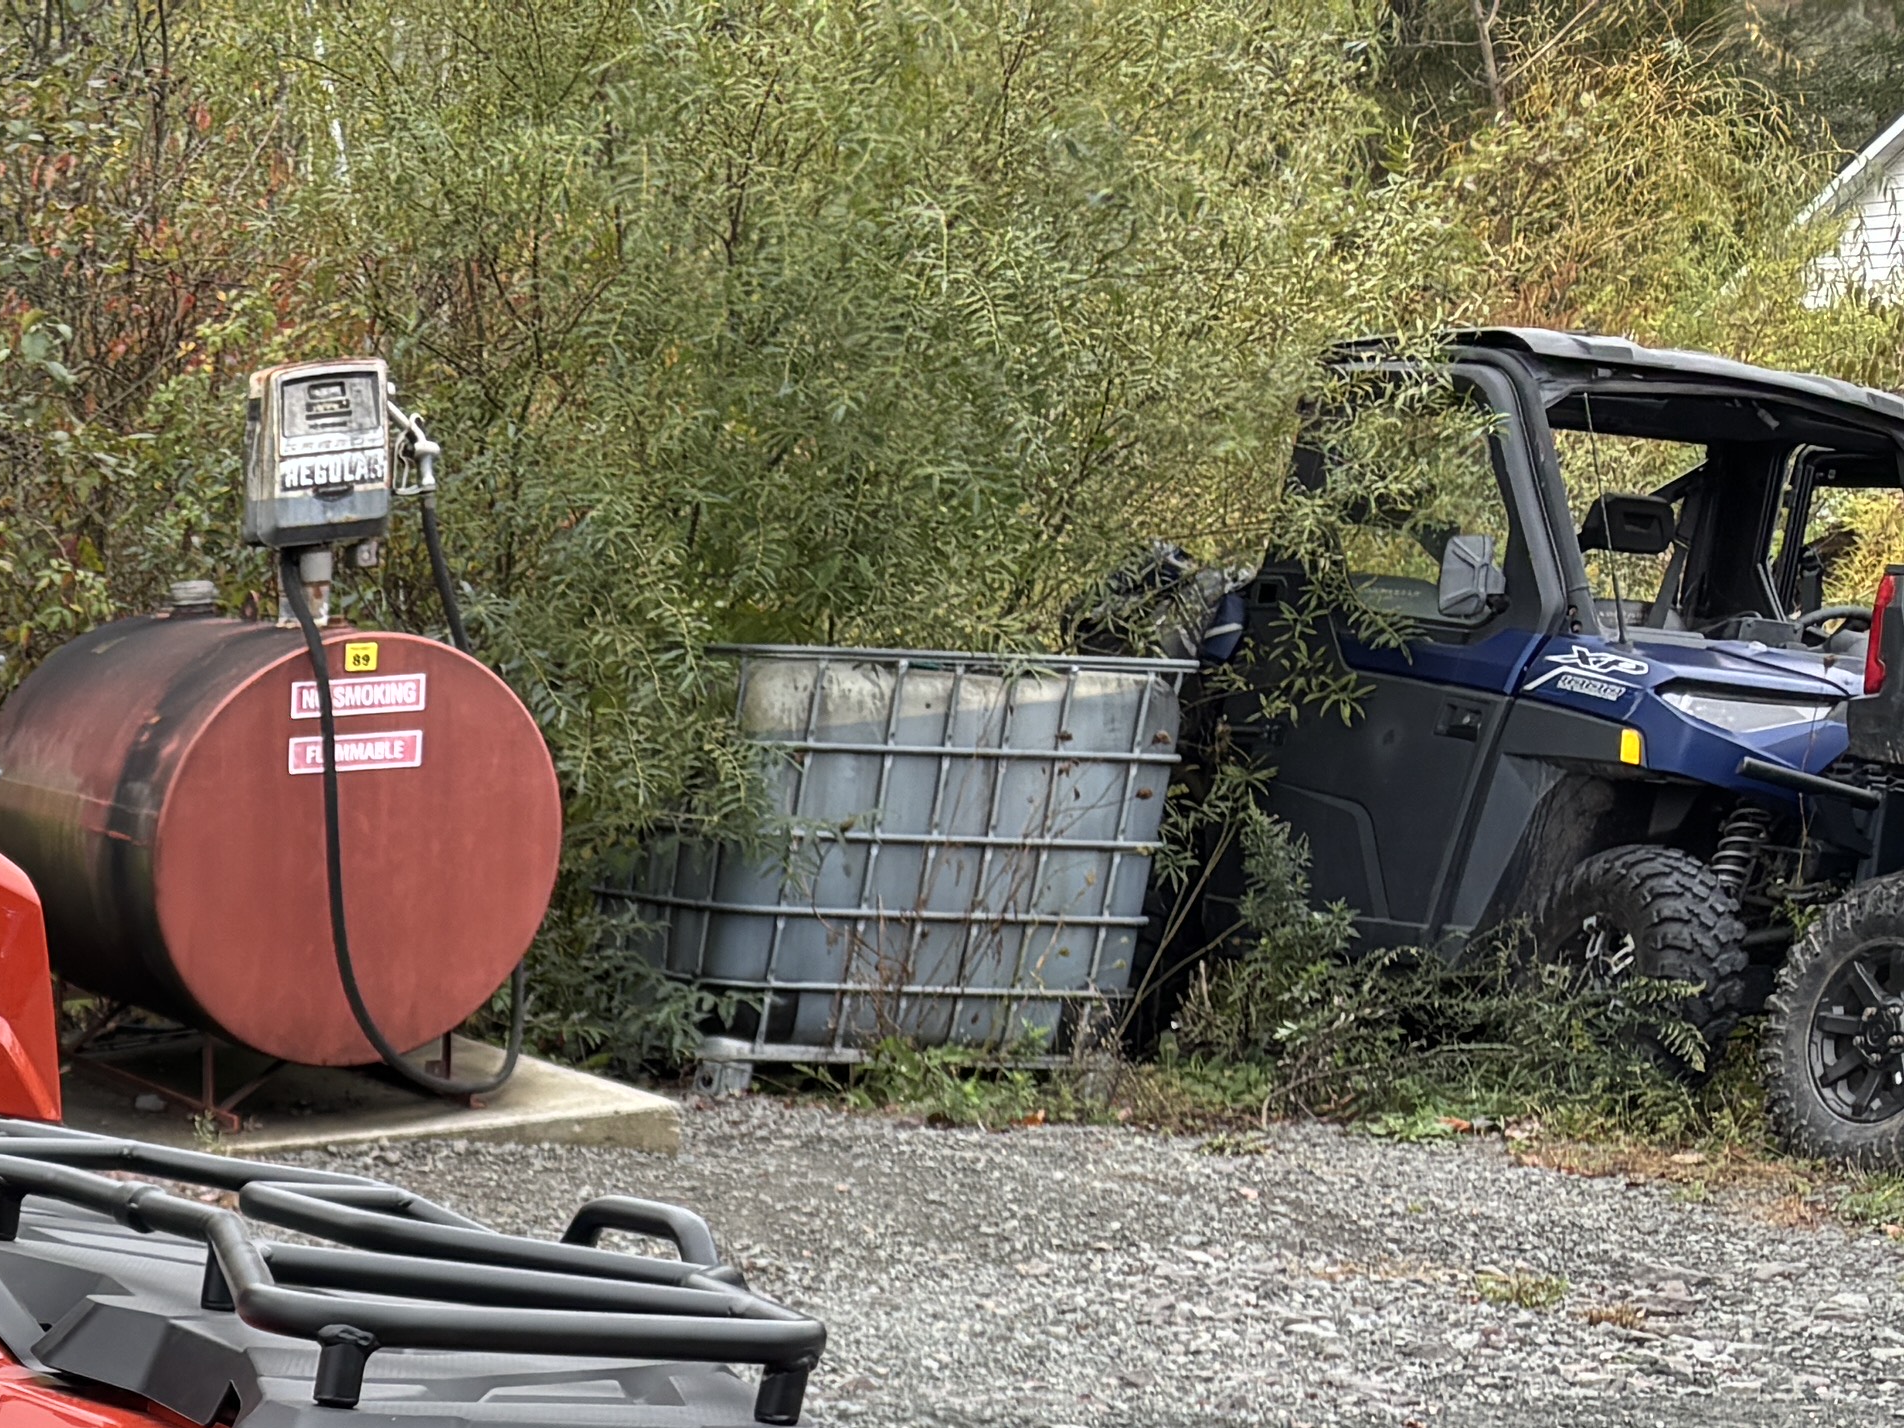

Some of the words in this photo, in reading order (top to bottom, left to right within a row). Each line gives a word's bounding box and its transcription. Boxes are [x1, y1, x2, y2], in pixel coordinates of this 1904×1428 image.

[352, 653, 371, 667] 89
[333, 682, 417, 708] SMOKING
[305, 740, 405, 765] FLMMABLE
